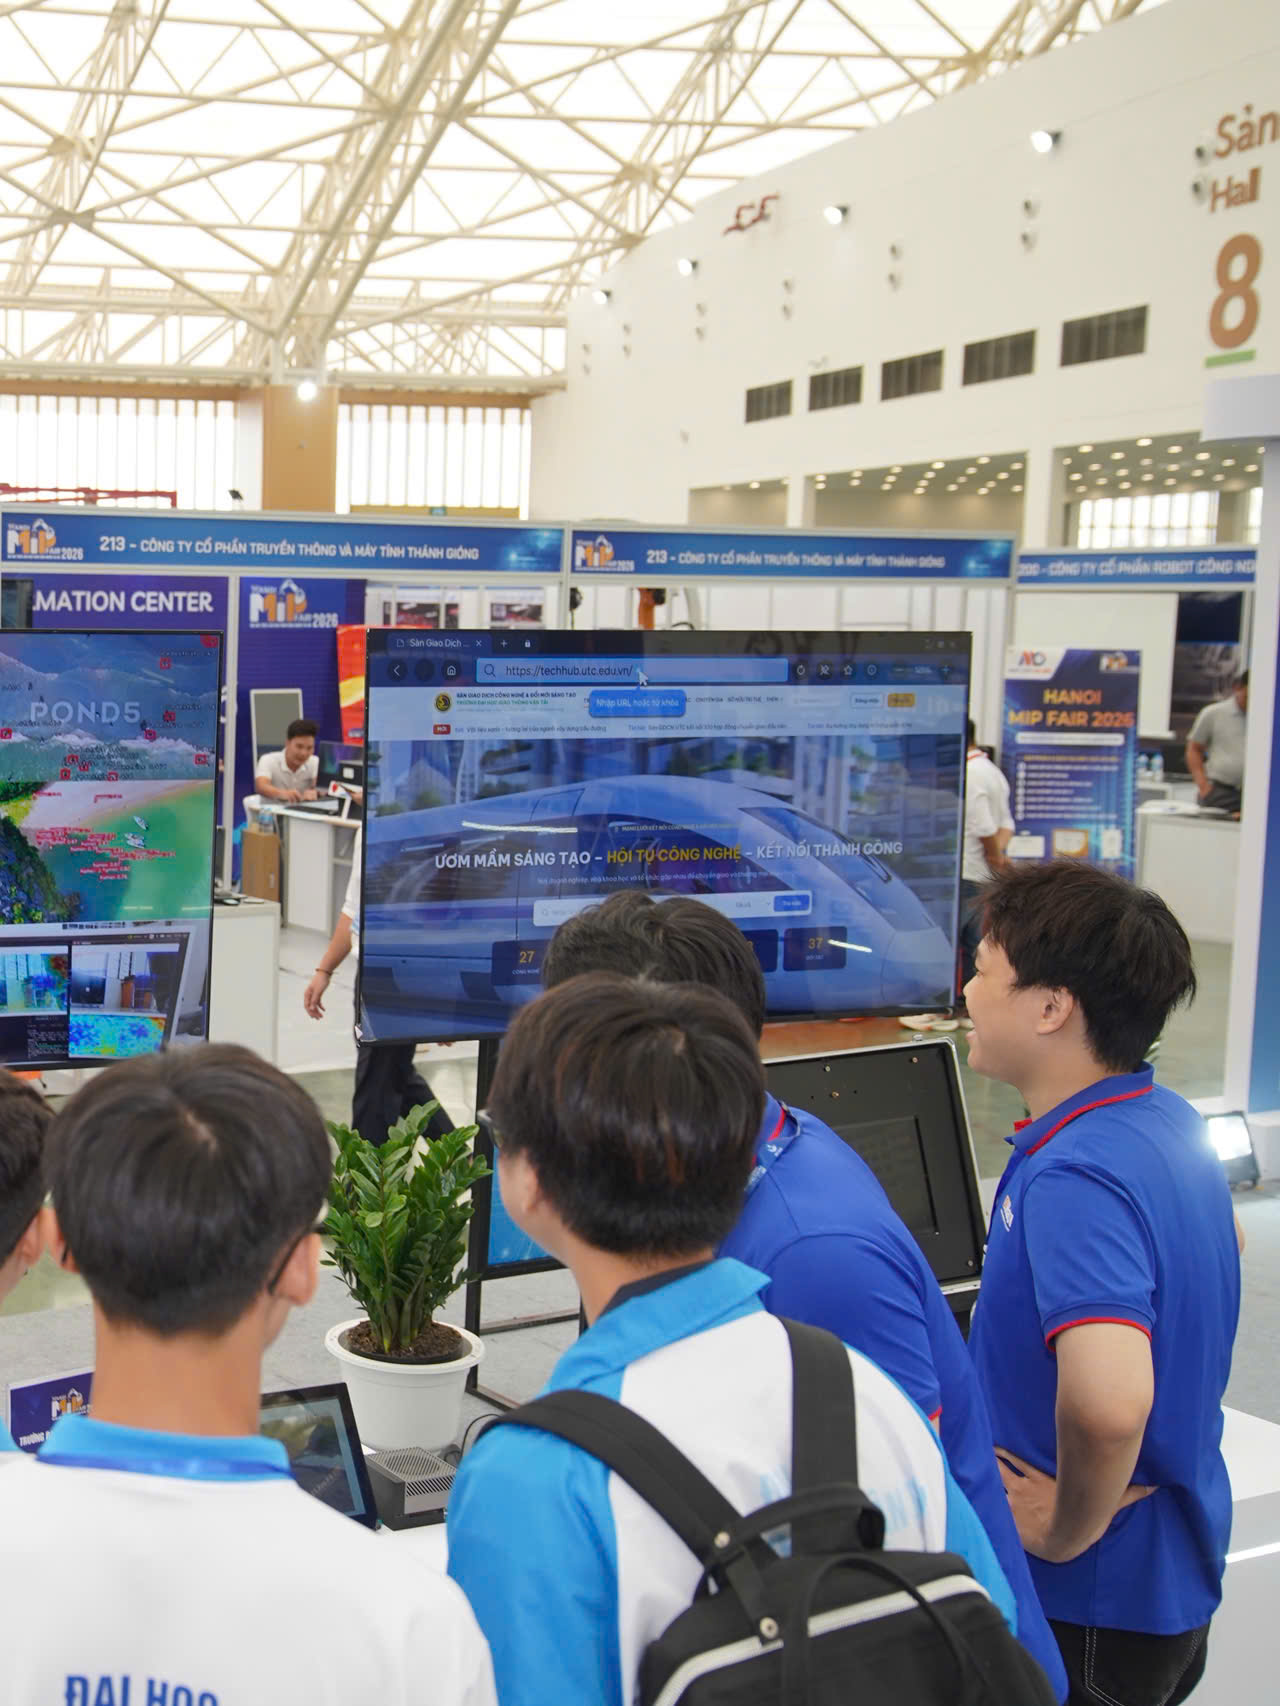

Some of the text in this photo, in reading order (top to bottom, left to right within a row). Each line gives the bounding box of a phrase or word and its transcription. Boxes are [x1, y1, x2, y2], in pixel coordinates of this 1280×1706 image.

[1214, 103, 1280, 159] Sản
[1209, 166, 1262, 214] Hall
[1209, 232, 1262, 350] 8
[61, 547, 84, 560] 2026
[99, 536, 126, 551] 213
[140, 538, 175, 554] CÔNG
[177, 540, 193, 553] TY
[298, 541, 337, 557] THÔNG
[354, 543, 378, 558] MÁY
[646, 550, 668, 564] 213
[707, 553, 719, 564] TY
[33, 590, 214, 612] MATION CENTER
[312, 613, 338, 628] 2026
[426, 638, 443, 648] Giao
[445, 638, 462, 649] Dịch
[505, 664, 633, 677] https://techhub.utc.edu.vn/
[1043, 688, 1103, 705] HANOI
[30, 701, 141, 724] POND5
[1008, 709, 1043, 726] MIP
[1046, 710, 1089, 727] FAIR
[434, 852, 470, 868] ƯƠM
[473, 847, 511, 868] MẦM
[514, 849, 555, 867] SÁNG
[558, 851, 591, 868] TẠO
[607, 846, 633, 867] HỘI
[635, 848, 657, 865] TỤ
[657, 845, 700, 862] CÔNG
[703, 842, 742, 863] NGHỆ
[756, 839, 783, 859] KẾT
[786, 838, 811, 857] NỐI
[813, 840, 860, 857] THÀNH
[862, 838, 904, 855] CÔNG
[808, 937, 824, 950] 37
[519, 950, 537, 964] 27
